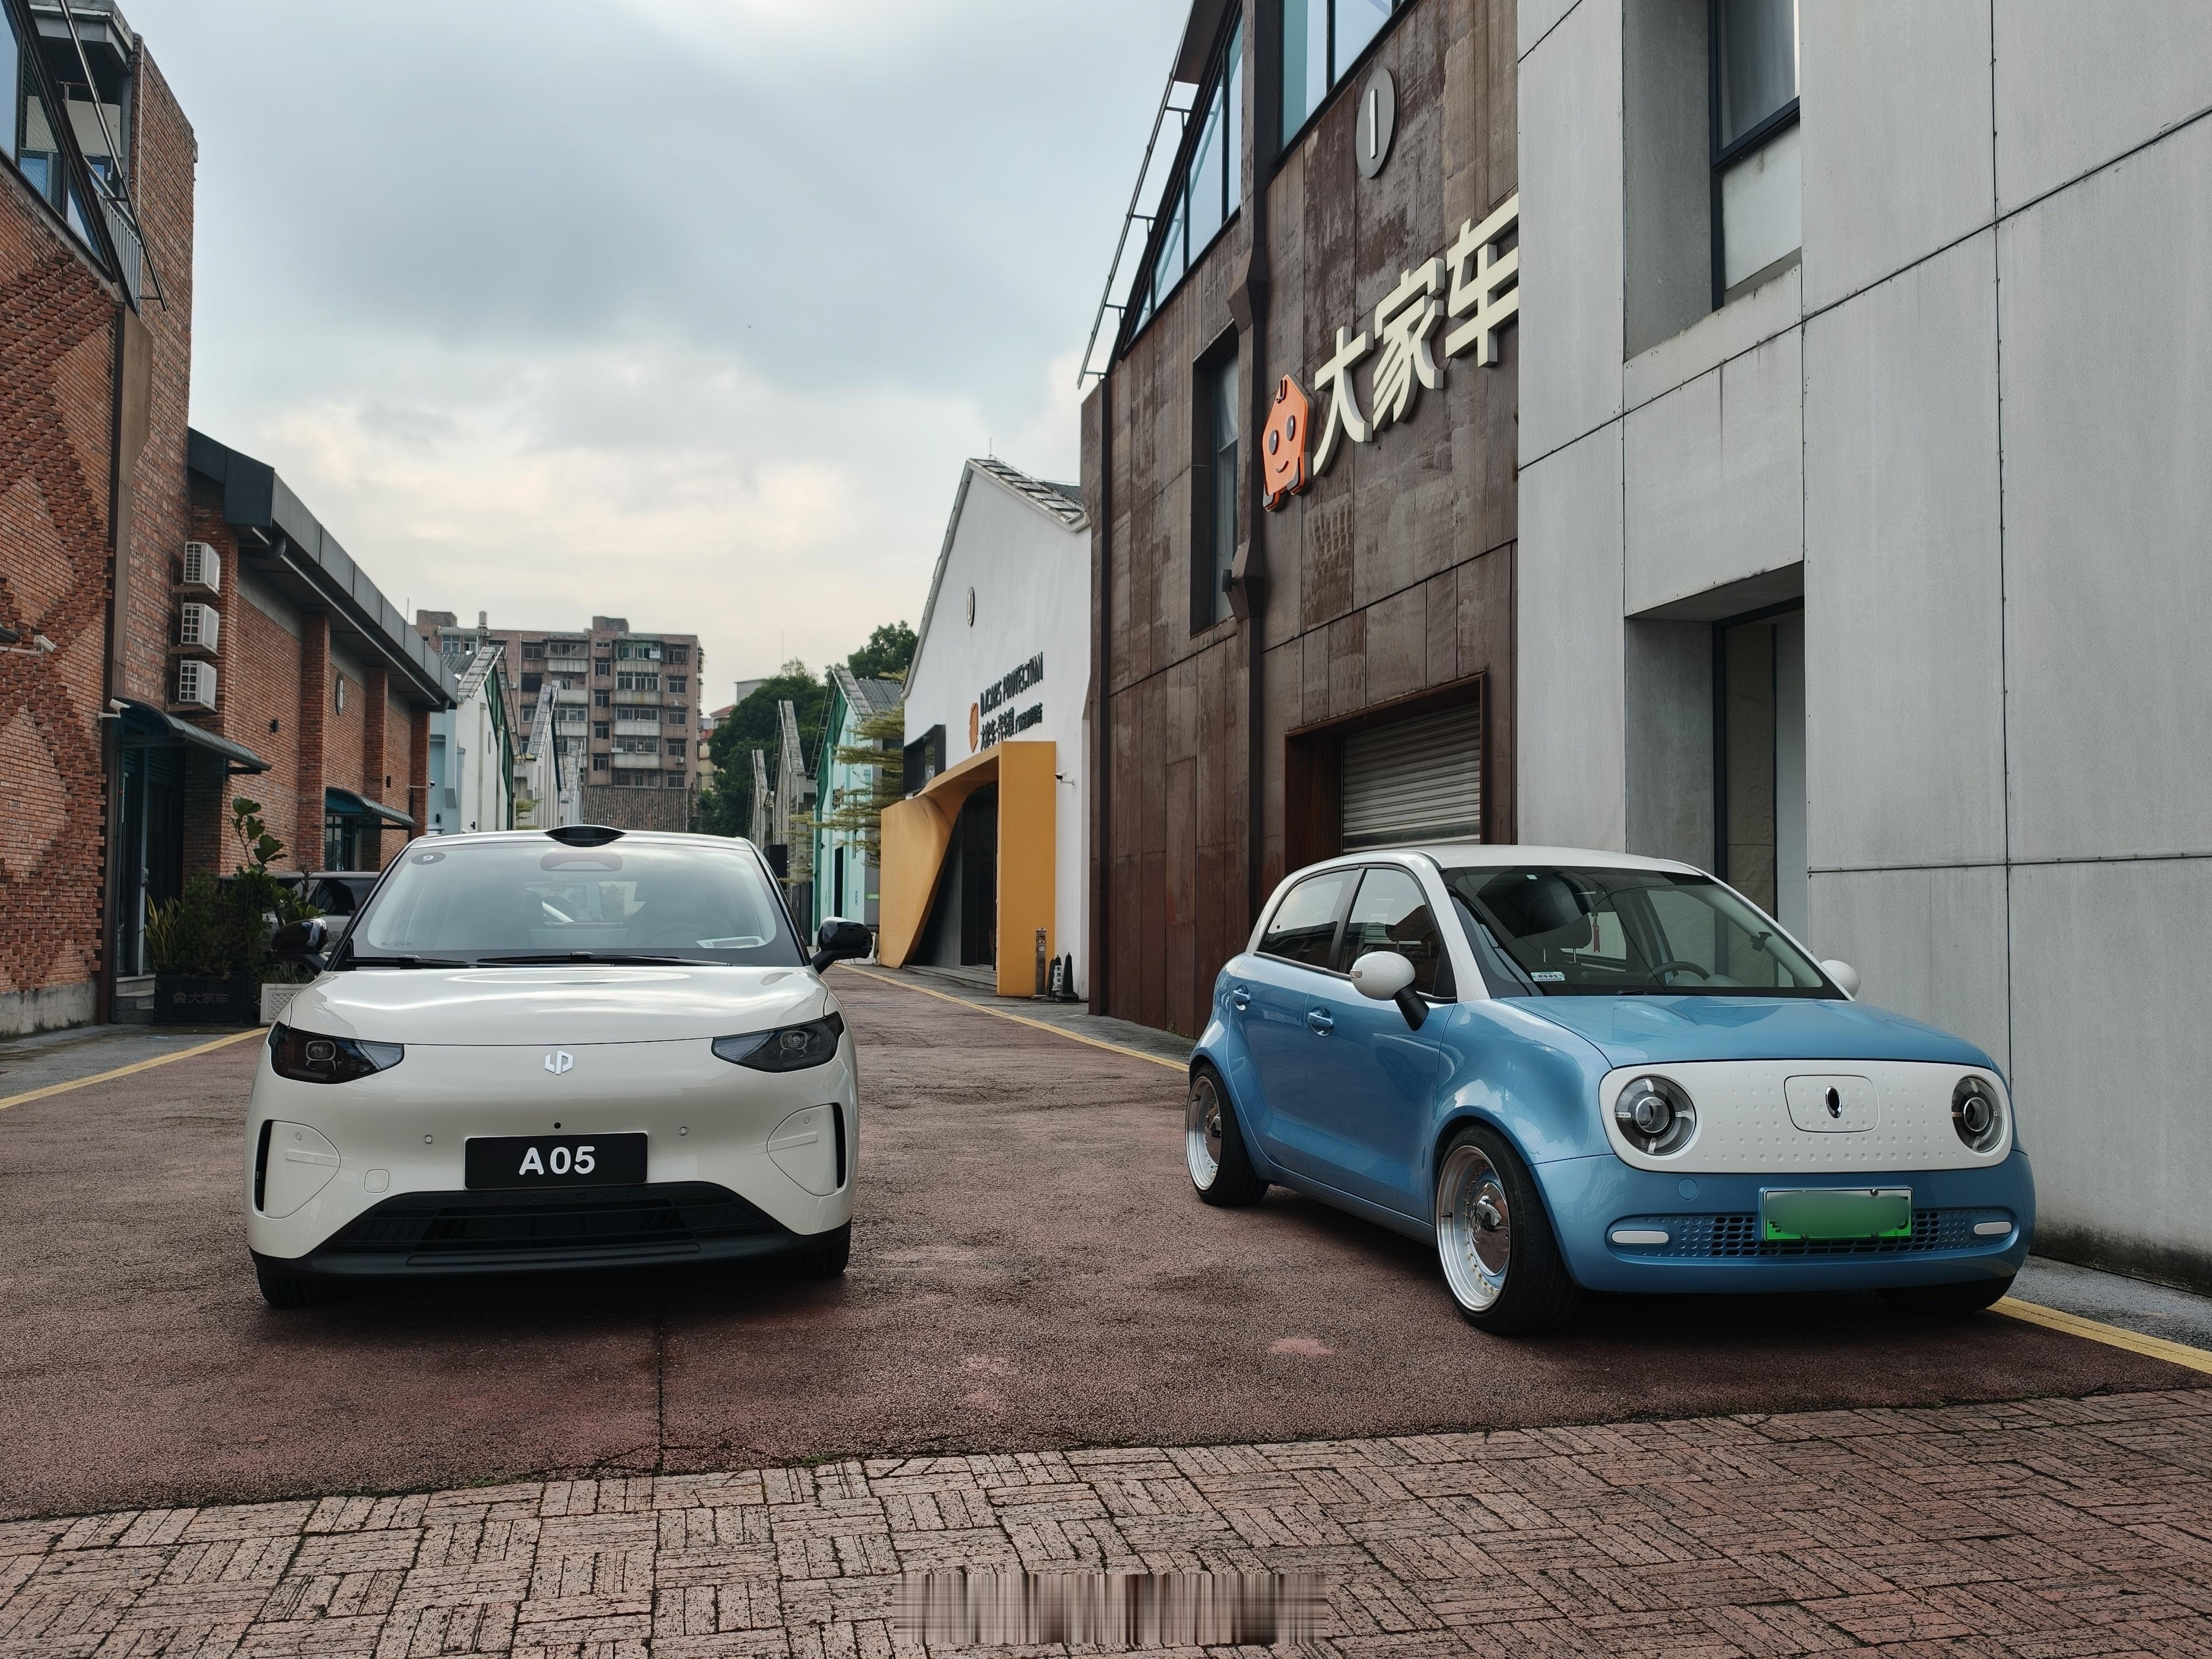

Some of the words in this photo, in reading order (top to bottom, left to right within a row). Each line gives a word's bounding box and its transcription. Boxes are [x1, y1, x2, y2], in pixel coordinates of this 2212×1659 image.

[1313, 192, 1519, 476] 大家车
[188, 993, 228, 1003] 大家车
[519, 1146, 595, 1175] A05
